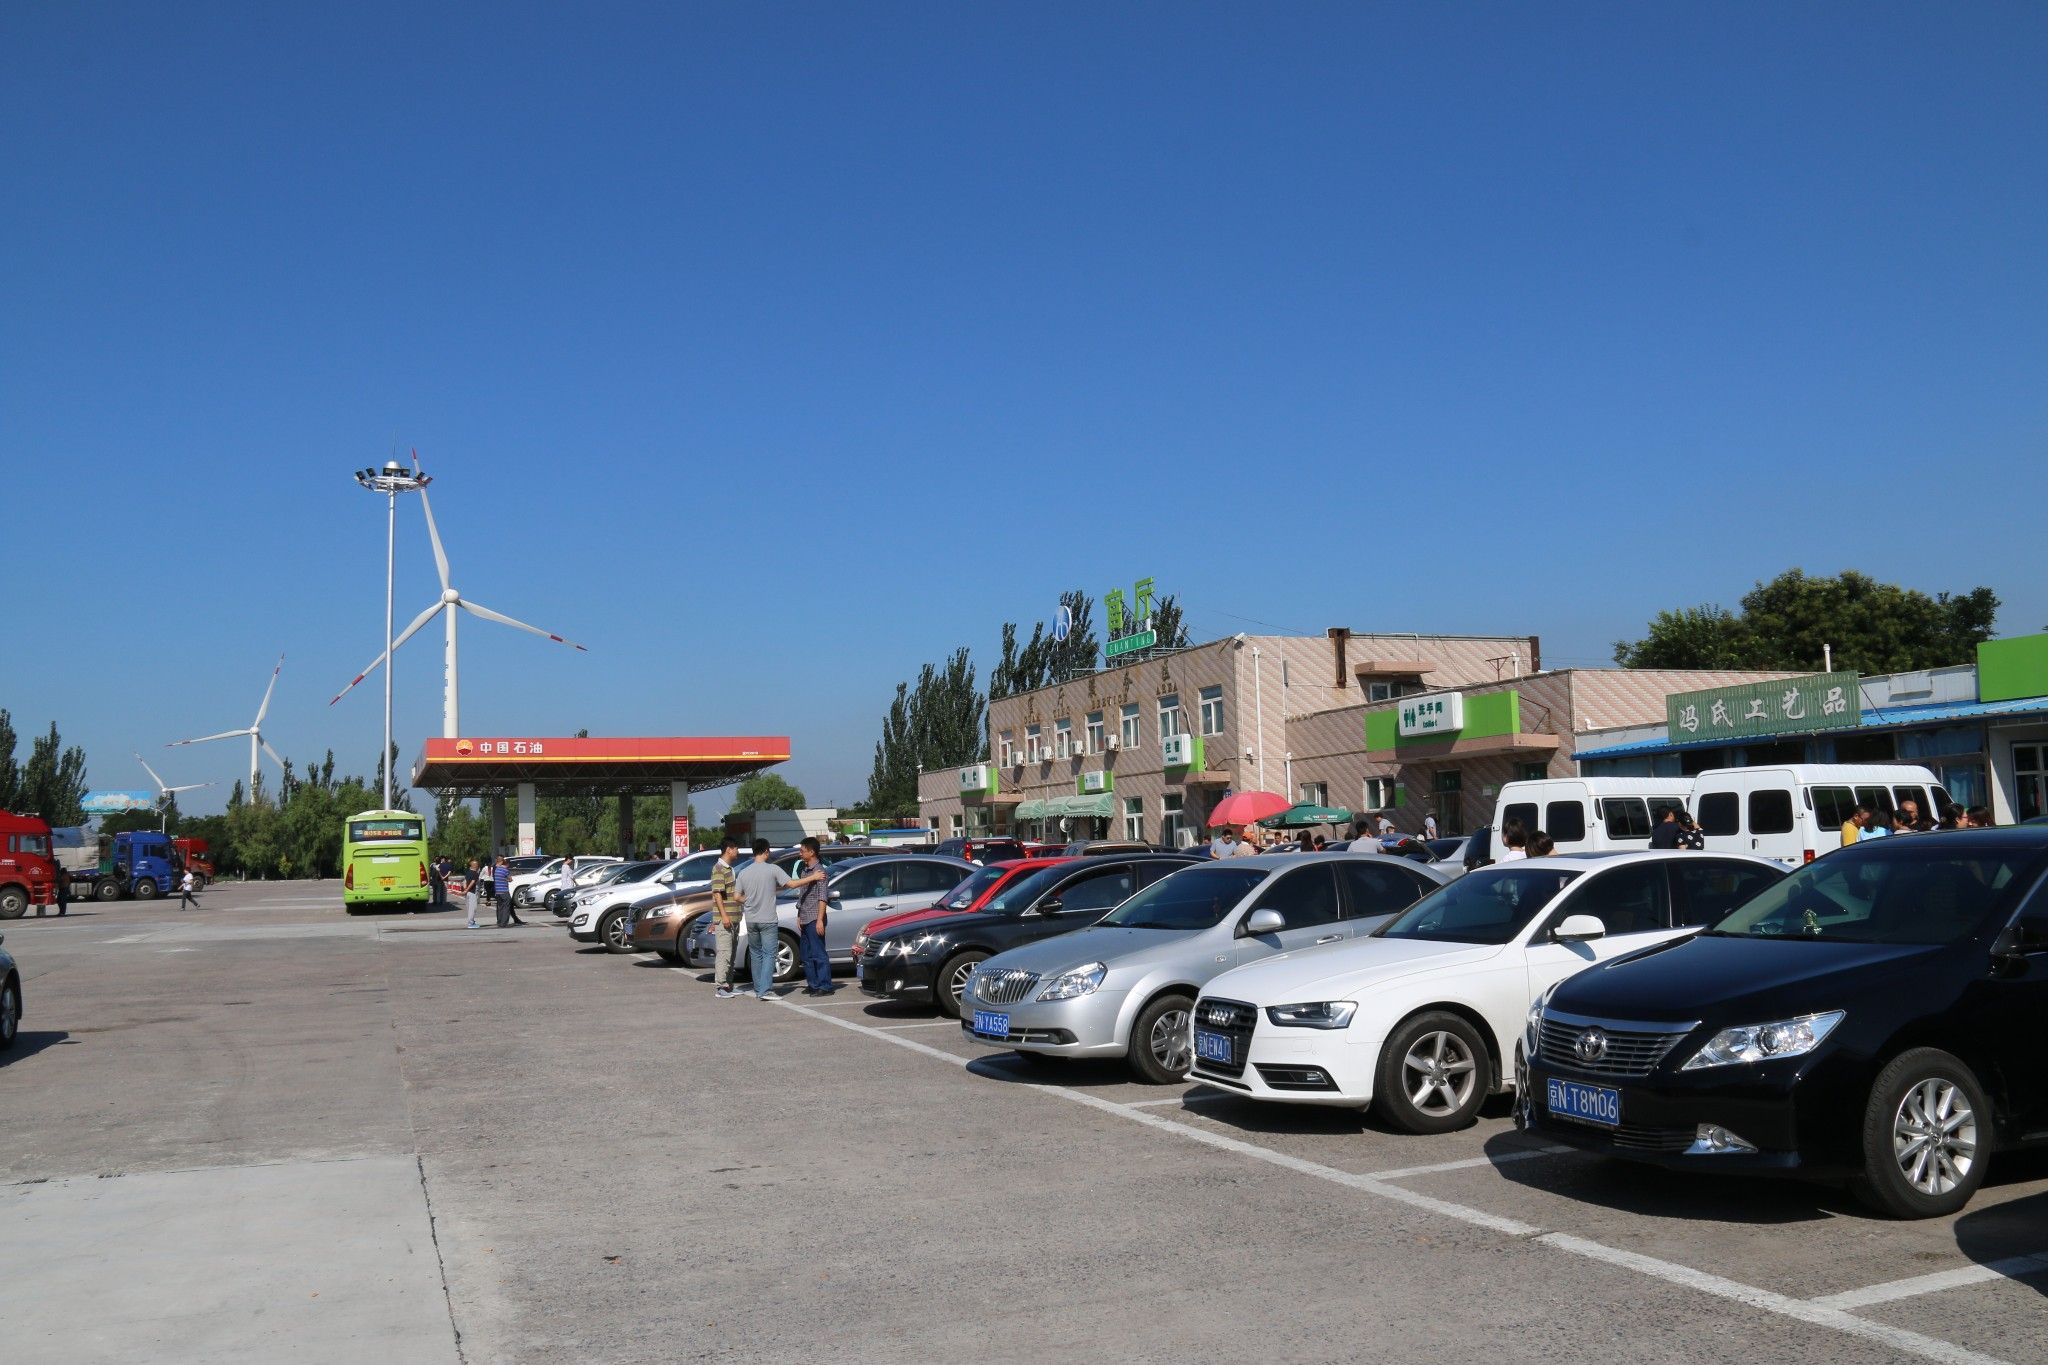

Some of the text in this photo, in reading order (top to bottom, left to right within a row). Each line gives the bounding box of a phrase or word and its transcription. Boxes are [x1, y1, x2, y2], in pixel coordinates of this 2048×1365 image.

[1104, 576, 1153, 632] 官厅
[1679, 686, 1847, 733] 冯氏工艺品
[480, 741, 543, 754] 中国石油
